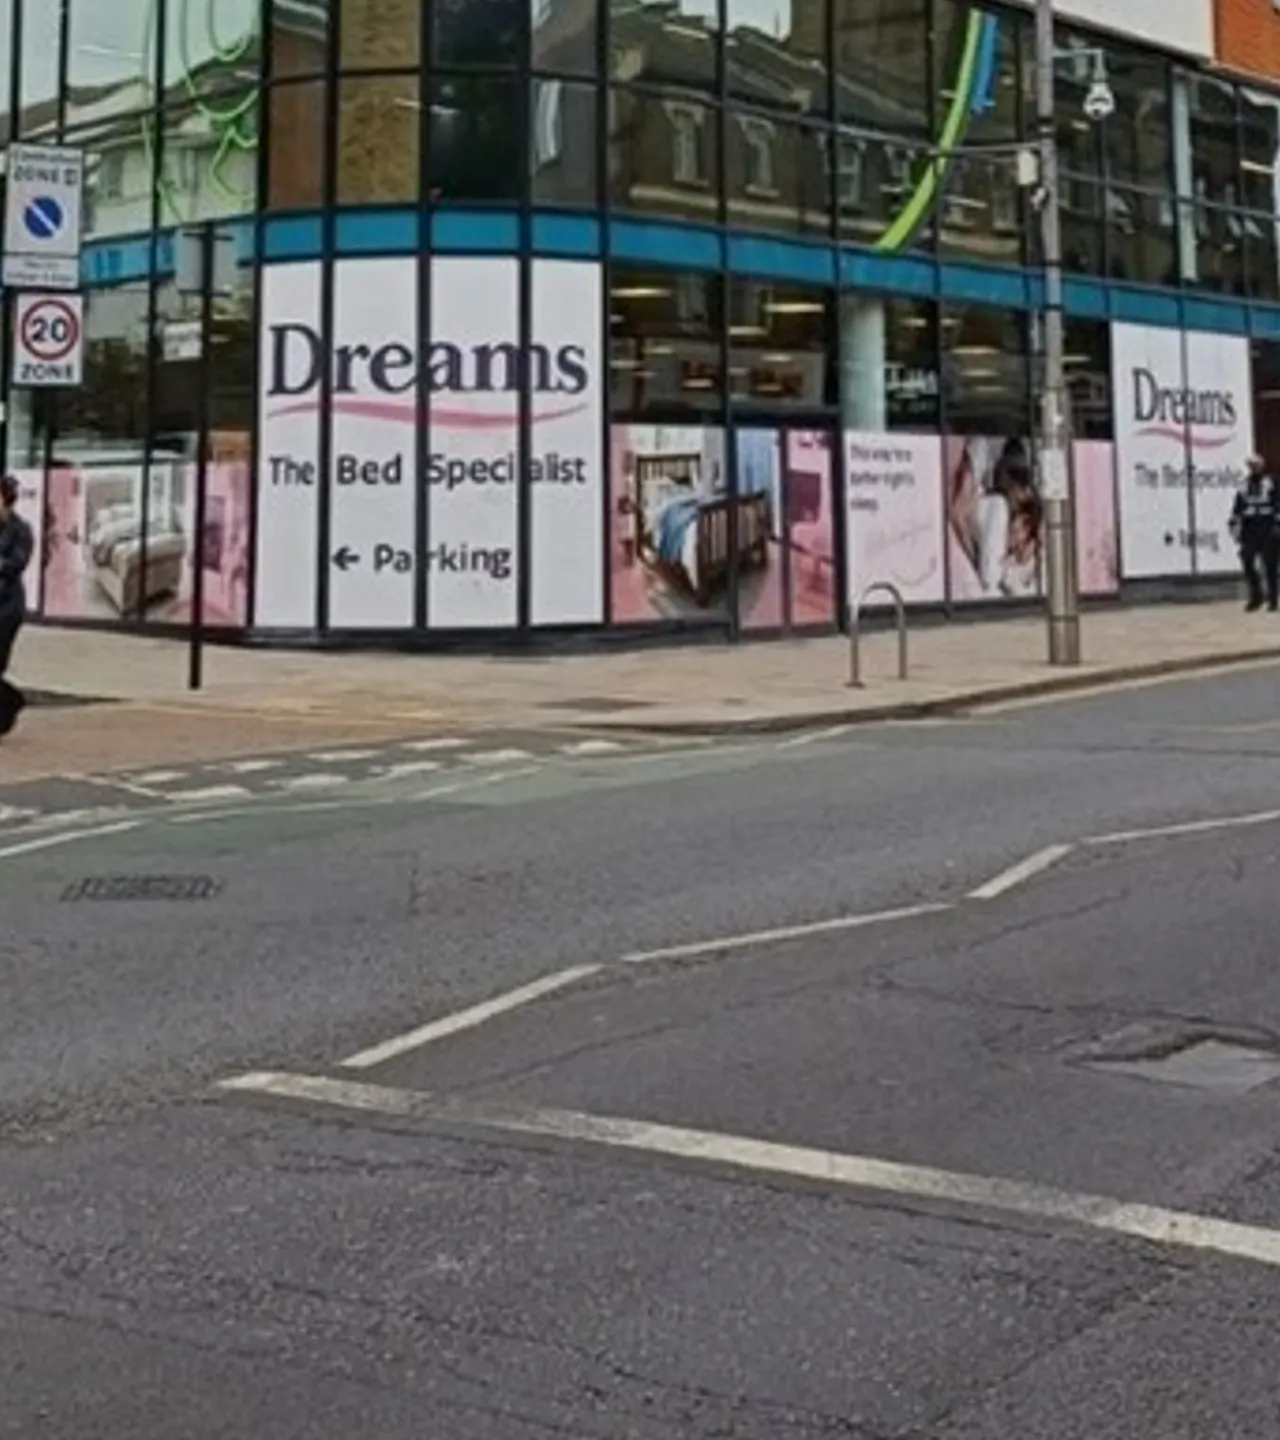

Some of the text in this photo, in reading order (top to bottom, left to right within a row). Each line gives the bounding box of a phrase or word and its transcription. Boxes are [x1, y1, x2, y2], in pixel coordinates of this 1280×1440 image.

[32, 317, 68, 342] 20
[22, 363, 74, 380] ZONE
[267, 322, 589, 396] Dreams
[1132, 368, 1237, 424] Dreams
[269, 453, 586, 489] The Bed Specialist
[373, 543, 512, 579] Parking
